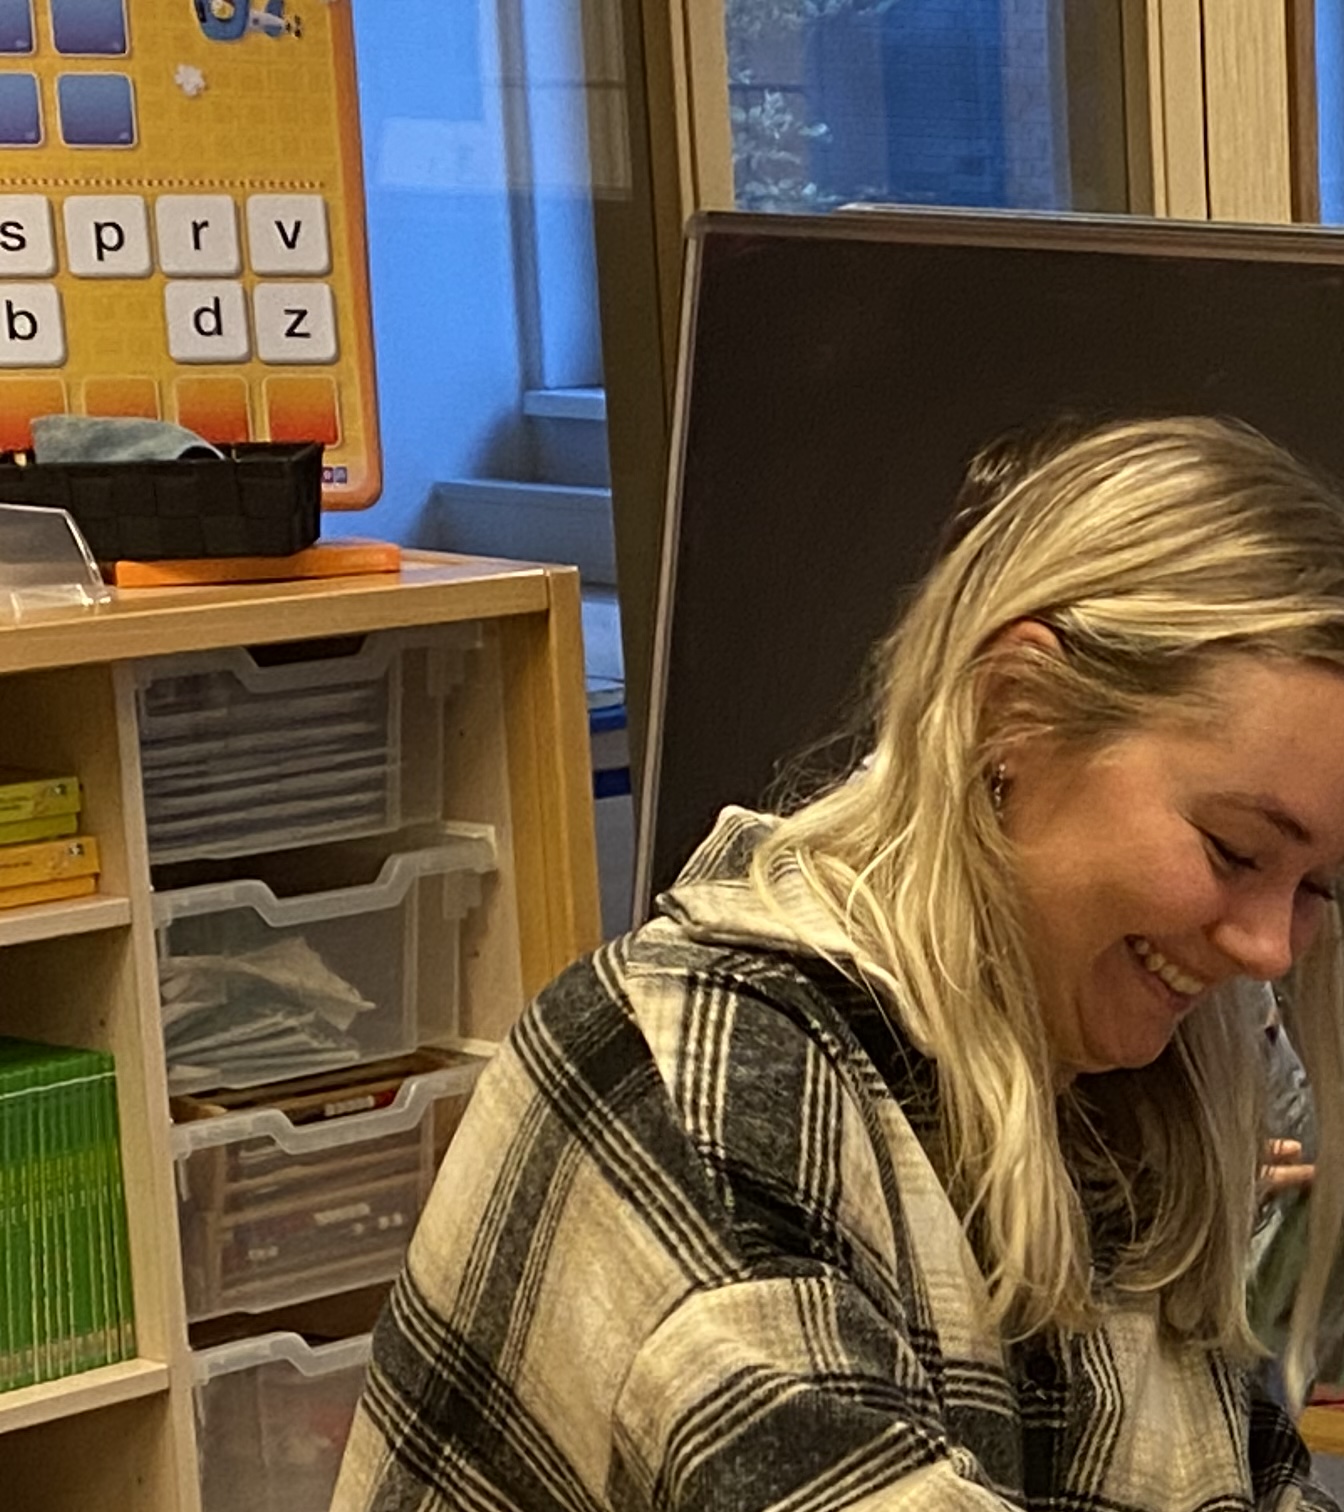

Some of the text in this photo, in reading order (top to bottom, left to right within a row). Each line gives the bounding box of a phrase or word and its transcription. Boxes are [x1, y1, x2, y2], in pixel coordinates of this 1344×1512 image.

[0, 218, 303, 262] s p r v
[6, 296, 312, 341] b d z
